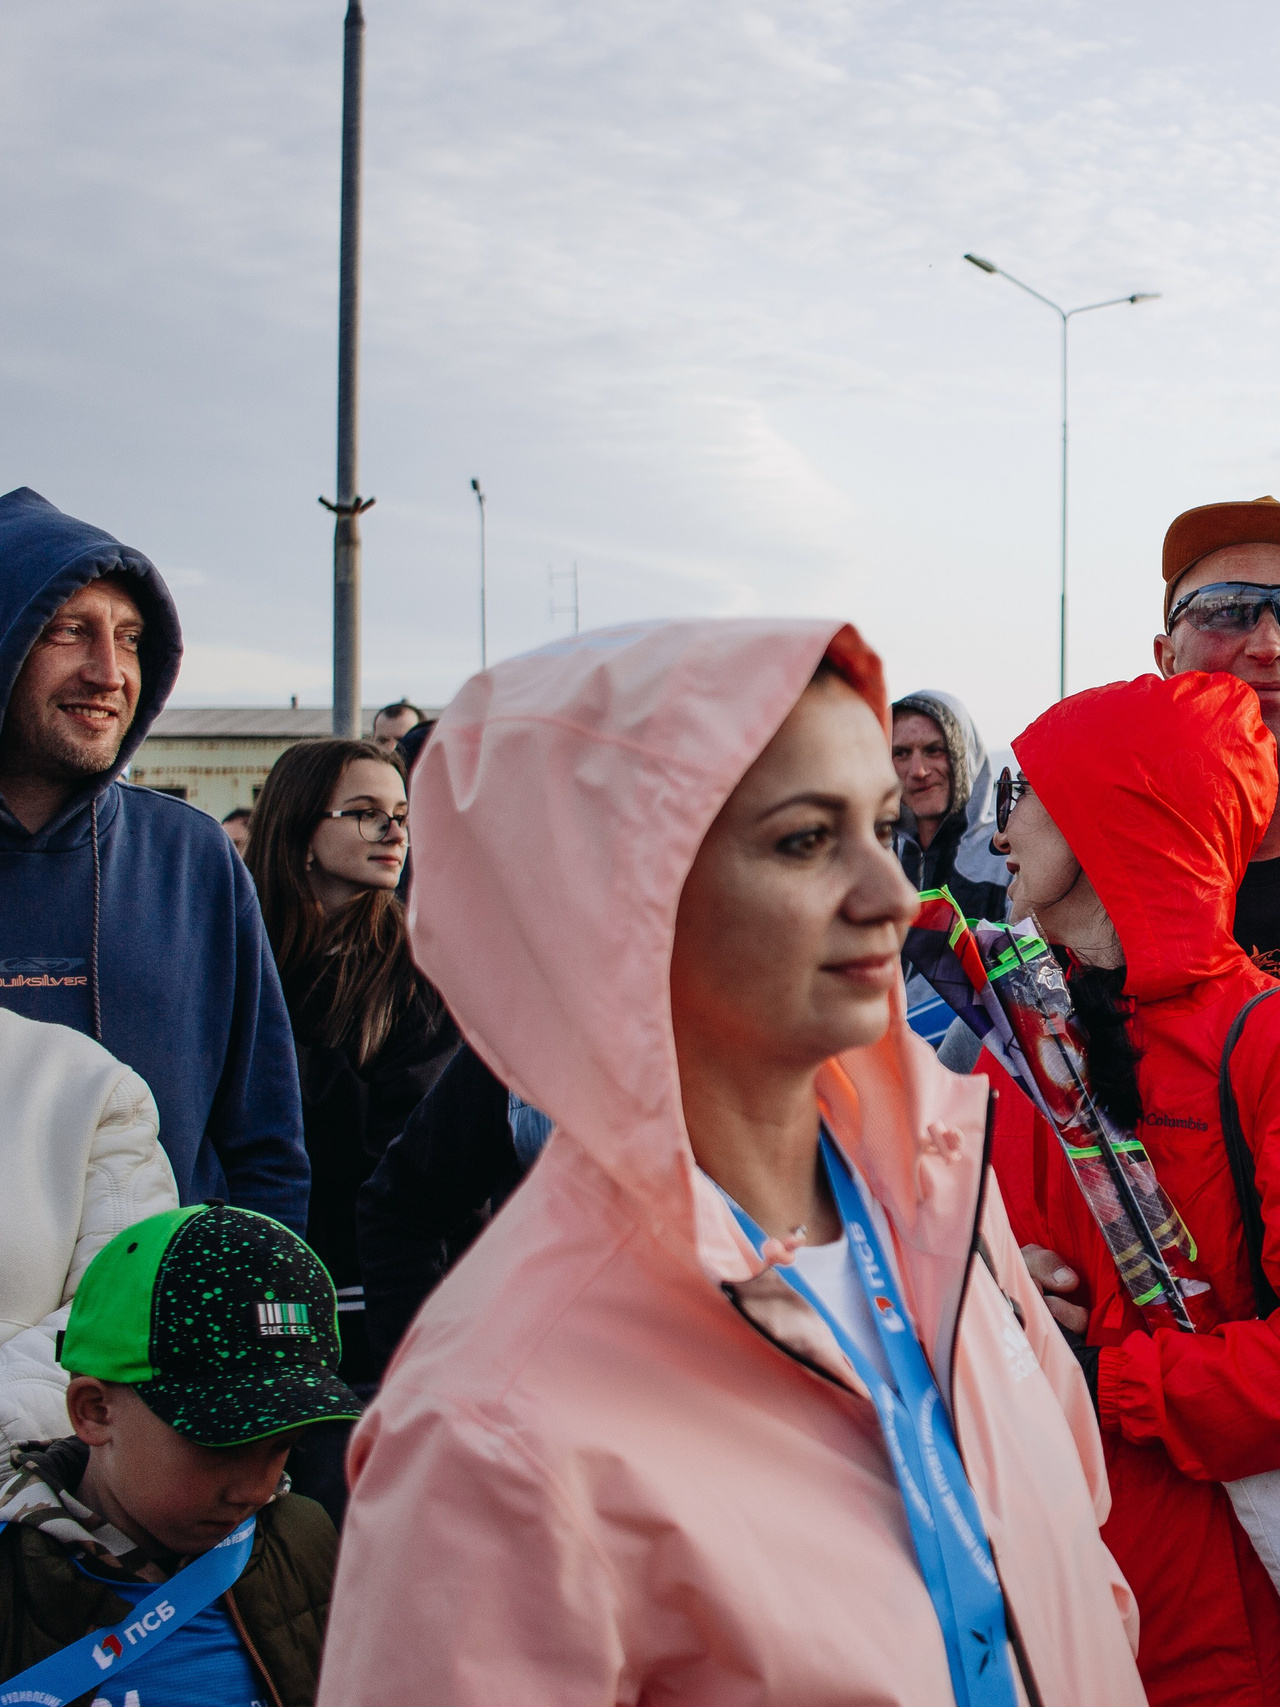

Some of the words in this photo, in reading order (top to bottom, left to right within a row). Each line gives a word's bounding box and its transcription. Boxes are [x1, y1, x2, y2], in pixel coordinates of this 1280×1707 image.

[1145, 1113, 1208, 1132] Columbia
[260, 1324, 312, 1336] SUCCESS
[123, 1600, 176, 1645] ПСБ
